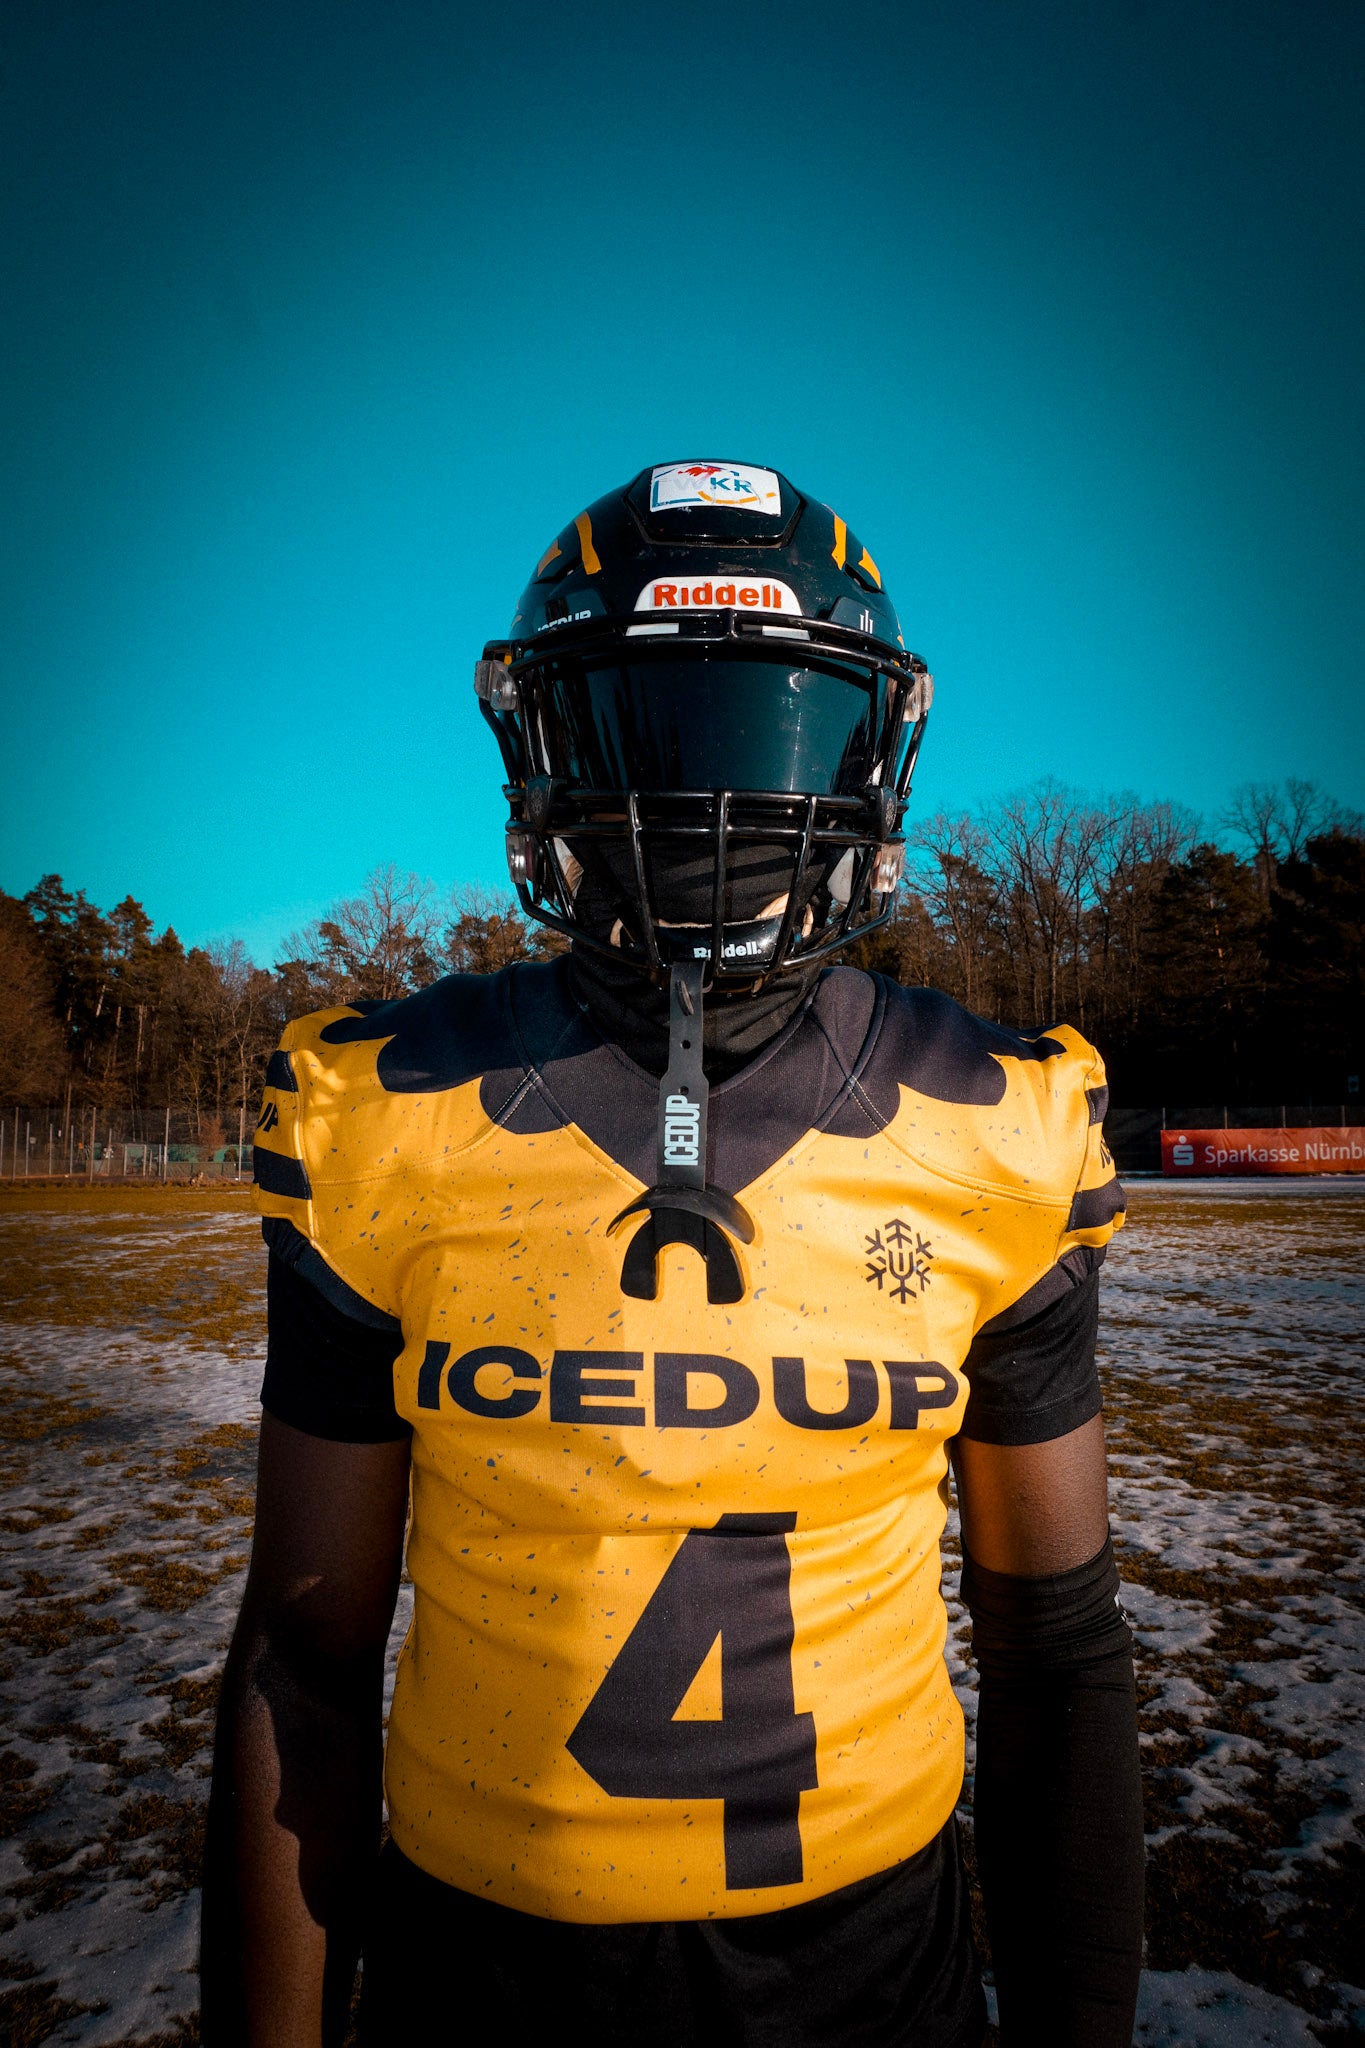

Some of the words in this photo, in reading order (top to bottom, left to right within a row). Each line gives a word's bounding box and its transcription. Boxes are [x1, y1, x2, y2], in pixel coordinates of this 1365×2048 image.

[653, 581, 783, 609] Riddell
[663, 1094, 701, 1166] ICEDUP
[1204, 1144, 1300, 1168] Sparkasse
[1304, 1142, 1365, 1161] Nürnb
[416, 1340, 960, 1431] ICEDUP
[564, 1511, 820, 1891] 4
